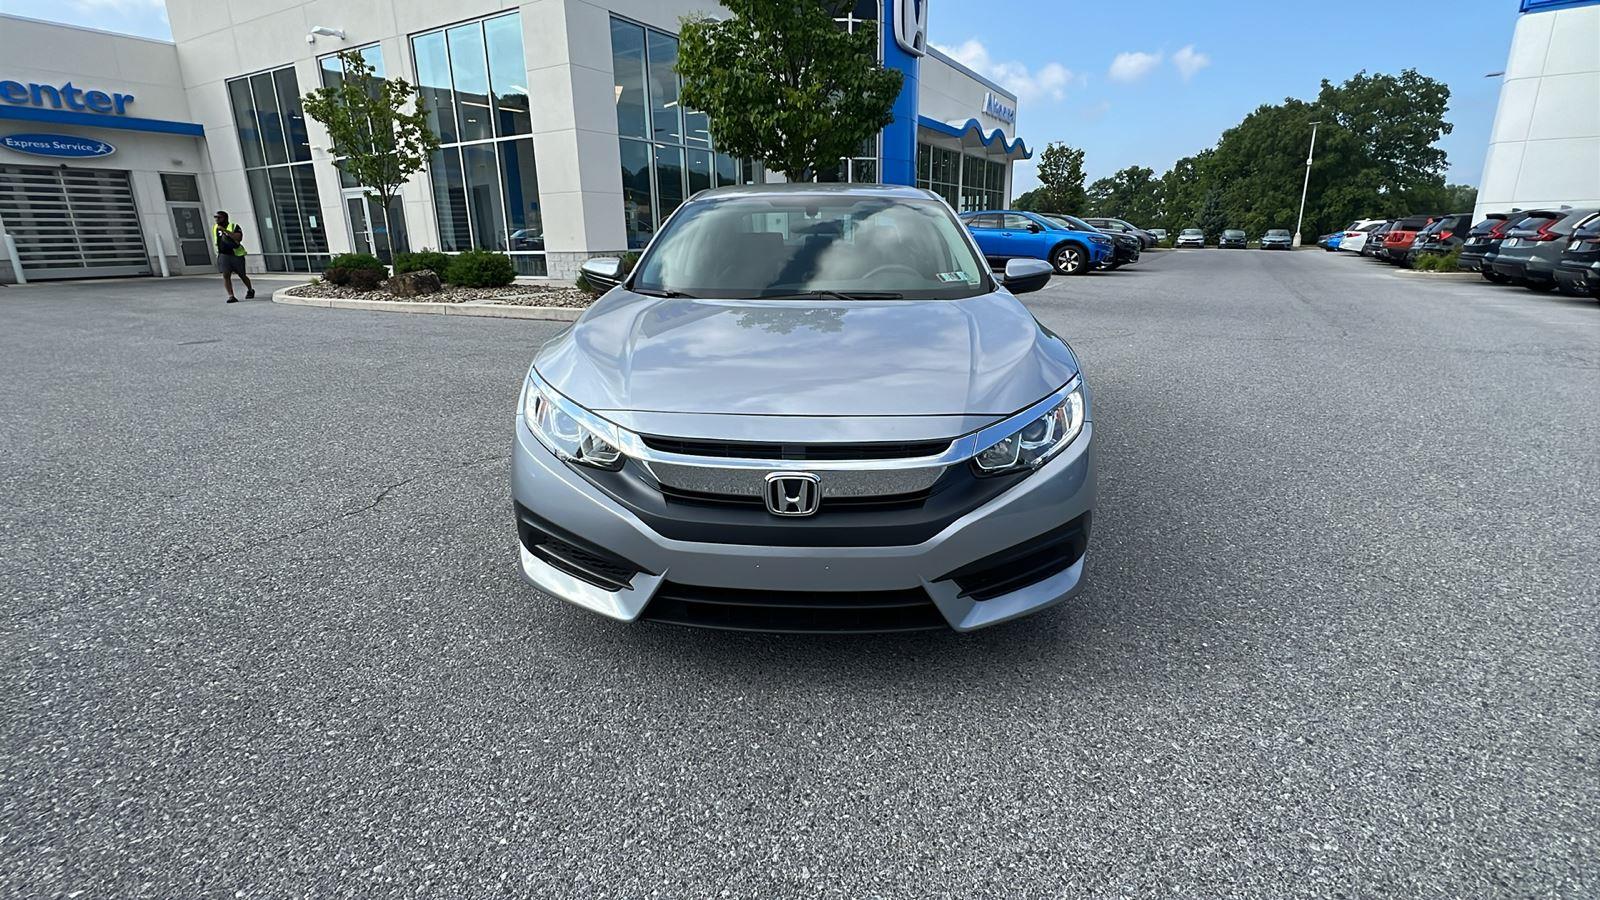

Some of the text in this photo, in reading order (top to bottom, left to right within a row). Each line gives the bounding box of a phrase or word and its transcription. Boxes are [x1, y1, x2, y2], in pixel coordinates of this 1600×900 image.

[0, 80, 135, 115] enter
[5, 137, 94, 151] Express Service
